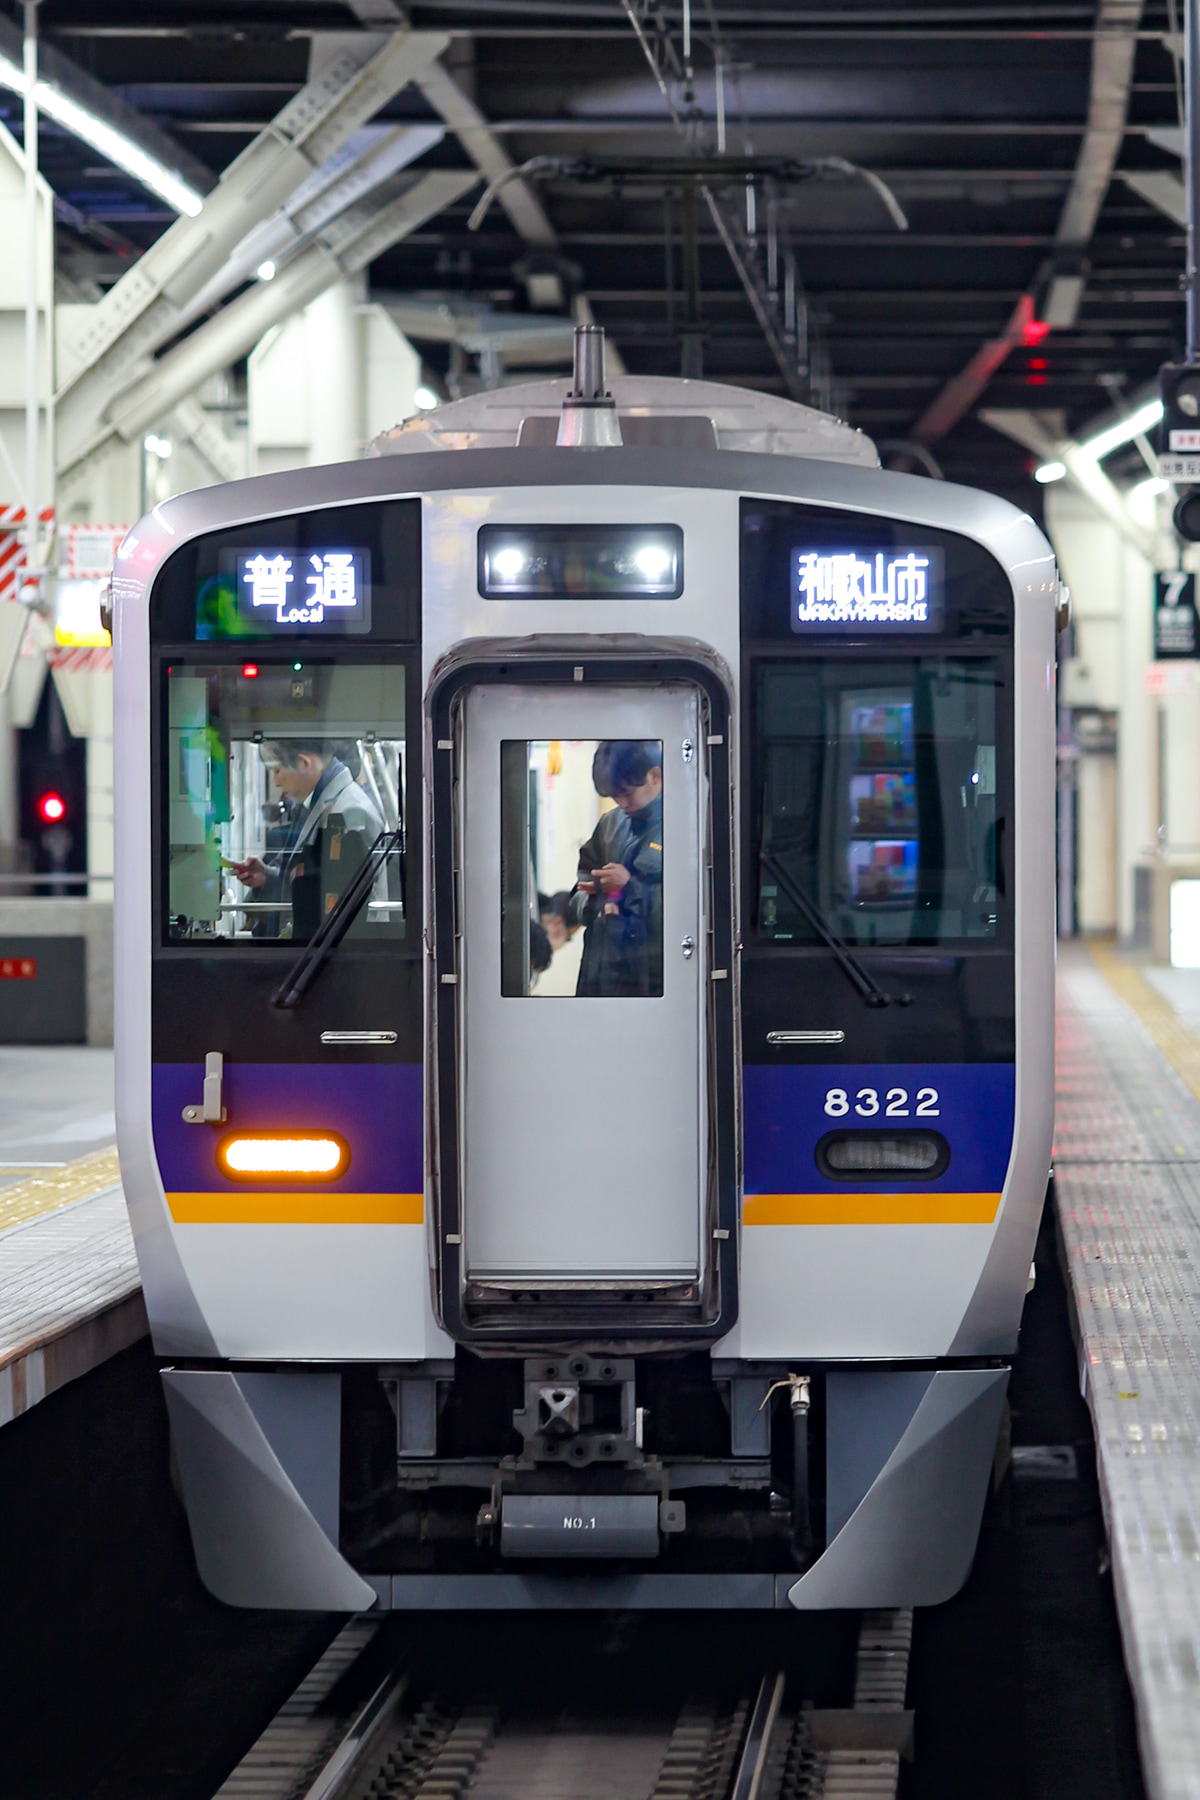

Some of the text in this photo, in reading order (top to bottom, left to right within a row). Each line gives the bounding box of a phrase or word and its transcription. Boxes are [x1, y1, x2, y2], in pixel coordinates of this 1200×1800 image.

[243, 554, 357, 607] 普通
[798, 553, 929, 605] 和歌山市
[1160, 571, 1189, 607] 7
[276, 604, 324, 623] Local
[824, 1088, 940, 1117] 8322
[563, 1517, 596, 1529] NO.1
